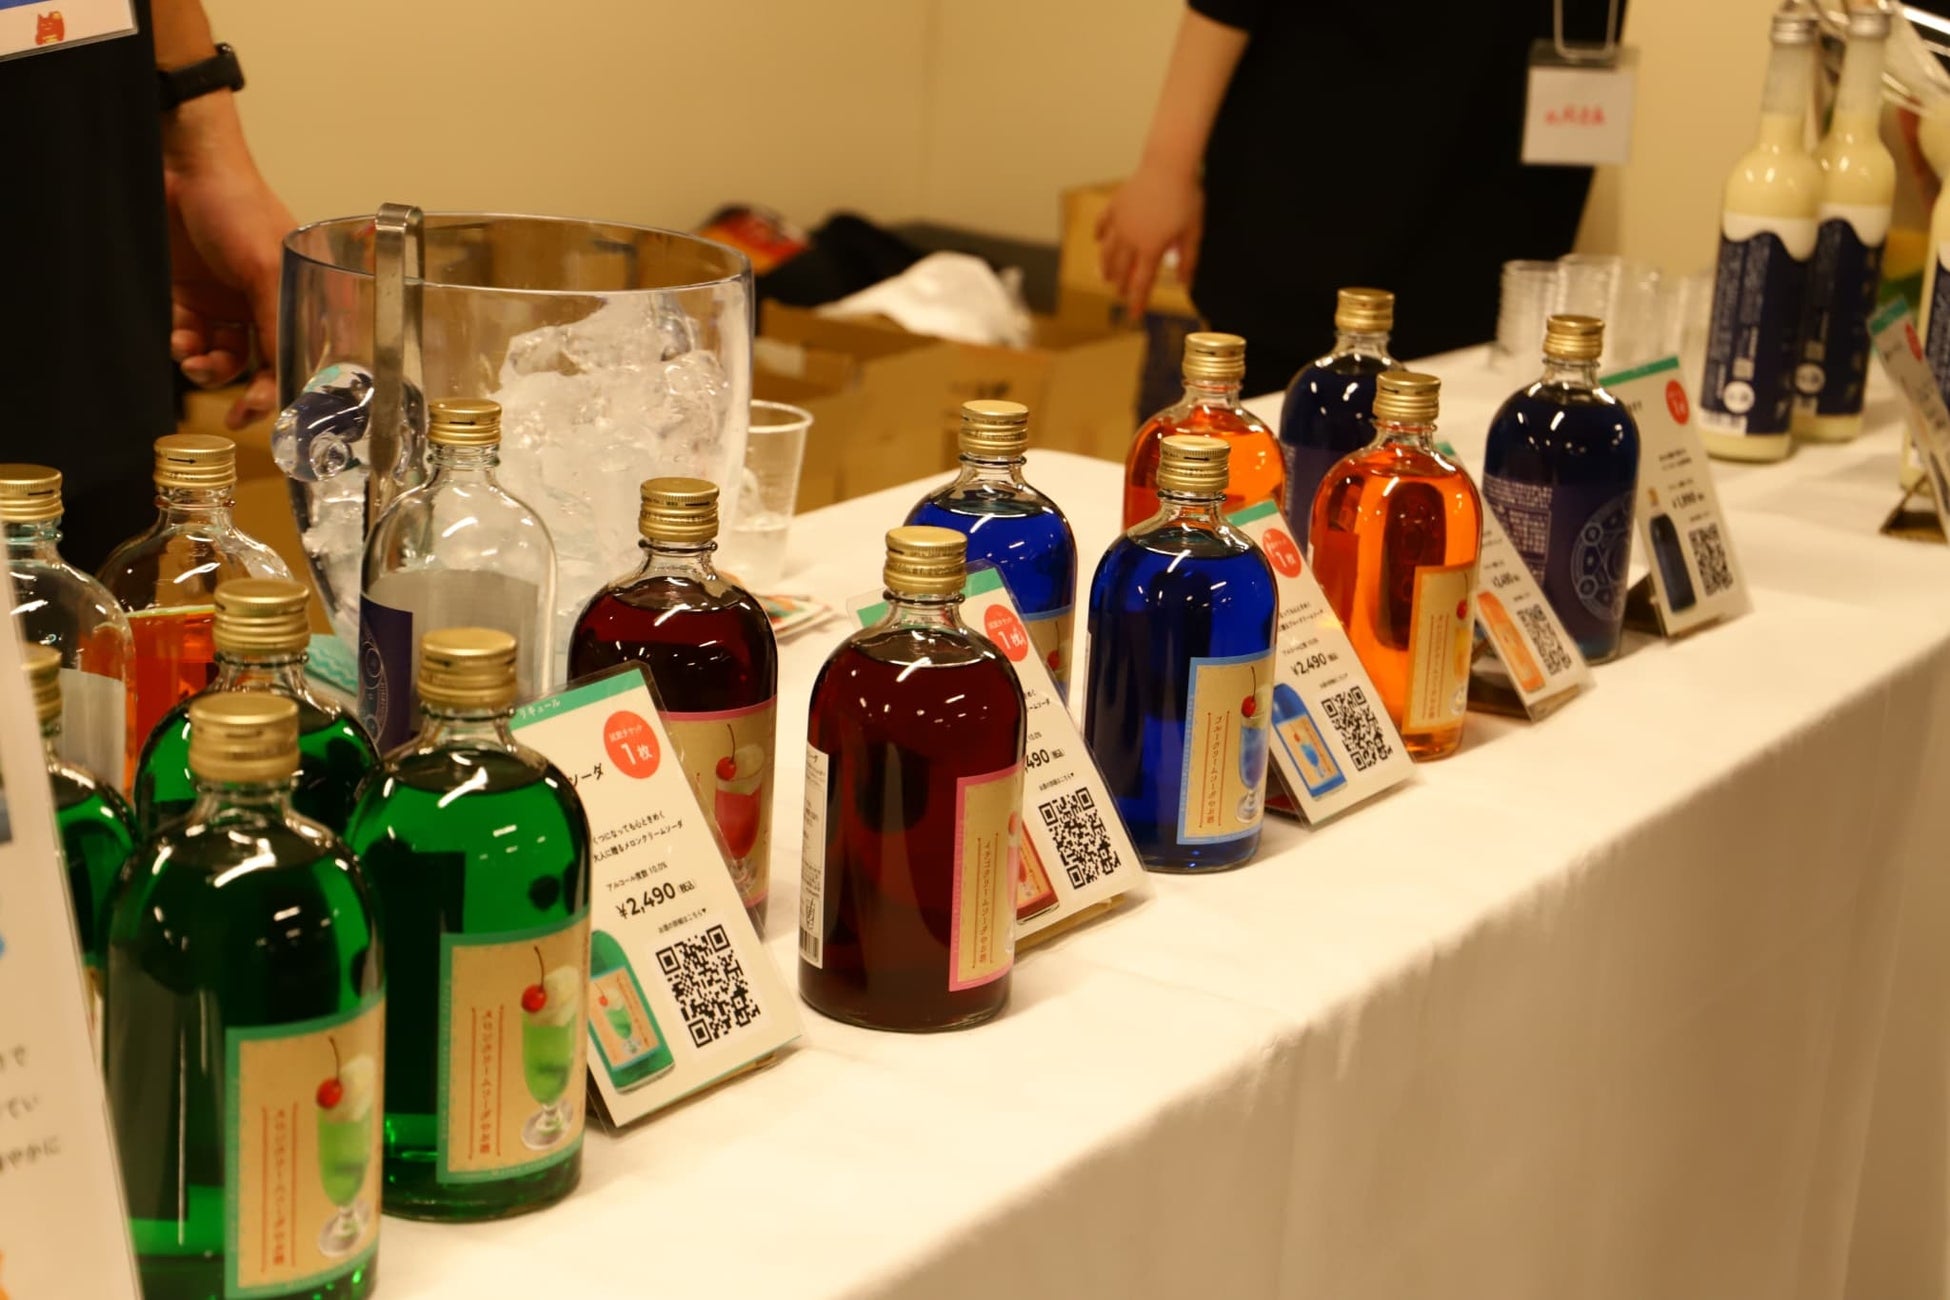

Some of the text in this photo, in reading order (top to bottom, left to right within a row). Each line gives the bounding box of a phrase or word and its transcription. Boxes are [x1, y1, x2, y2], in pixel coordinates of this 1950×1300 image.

[1290, 652, 1327, 677] ¥2,490
[620, 741, 654, 767] 1枚
[615, 881, 677, 920] ¥2,490
